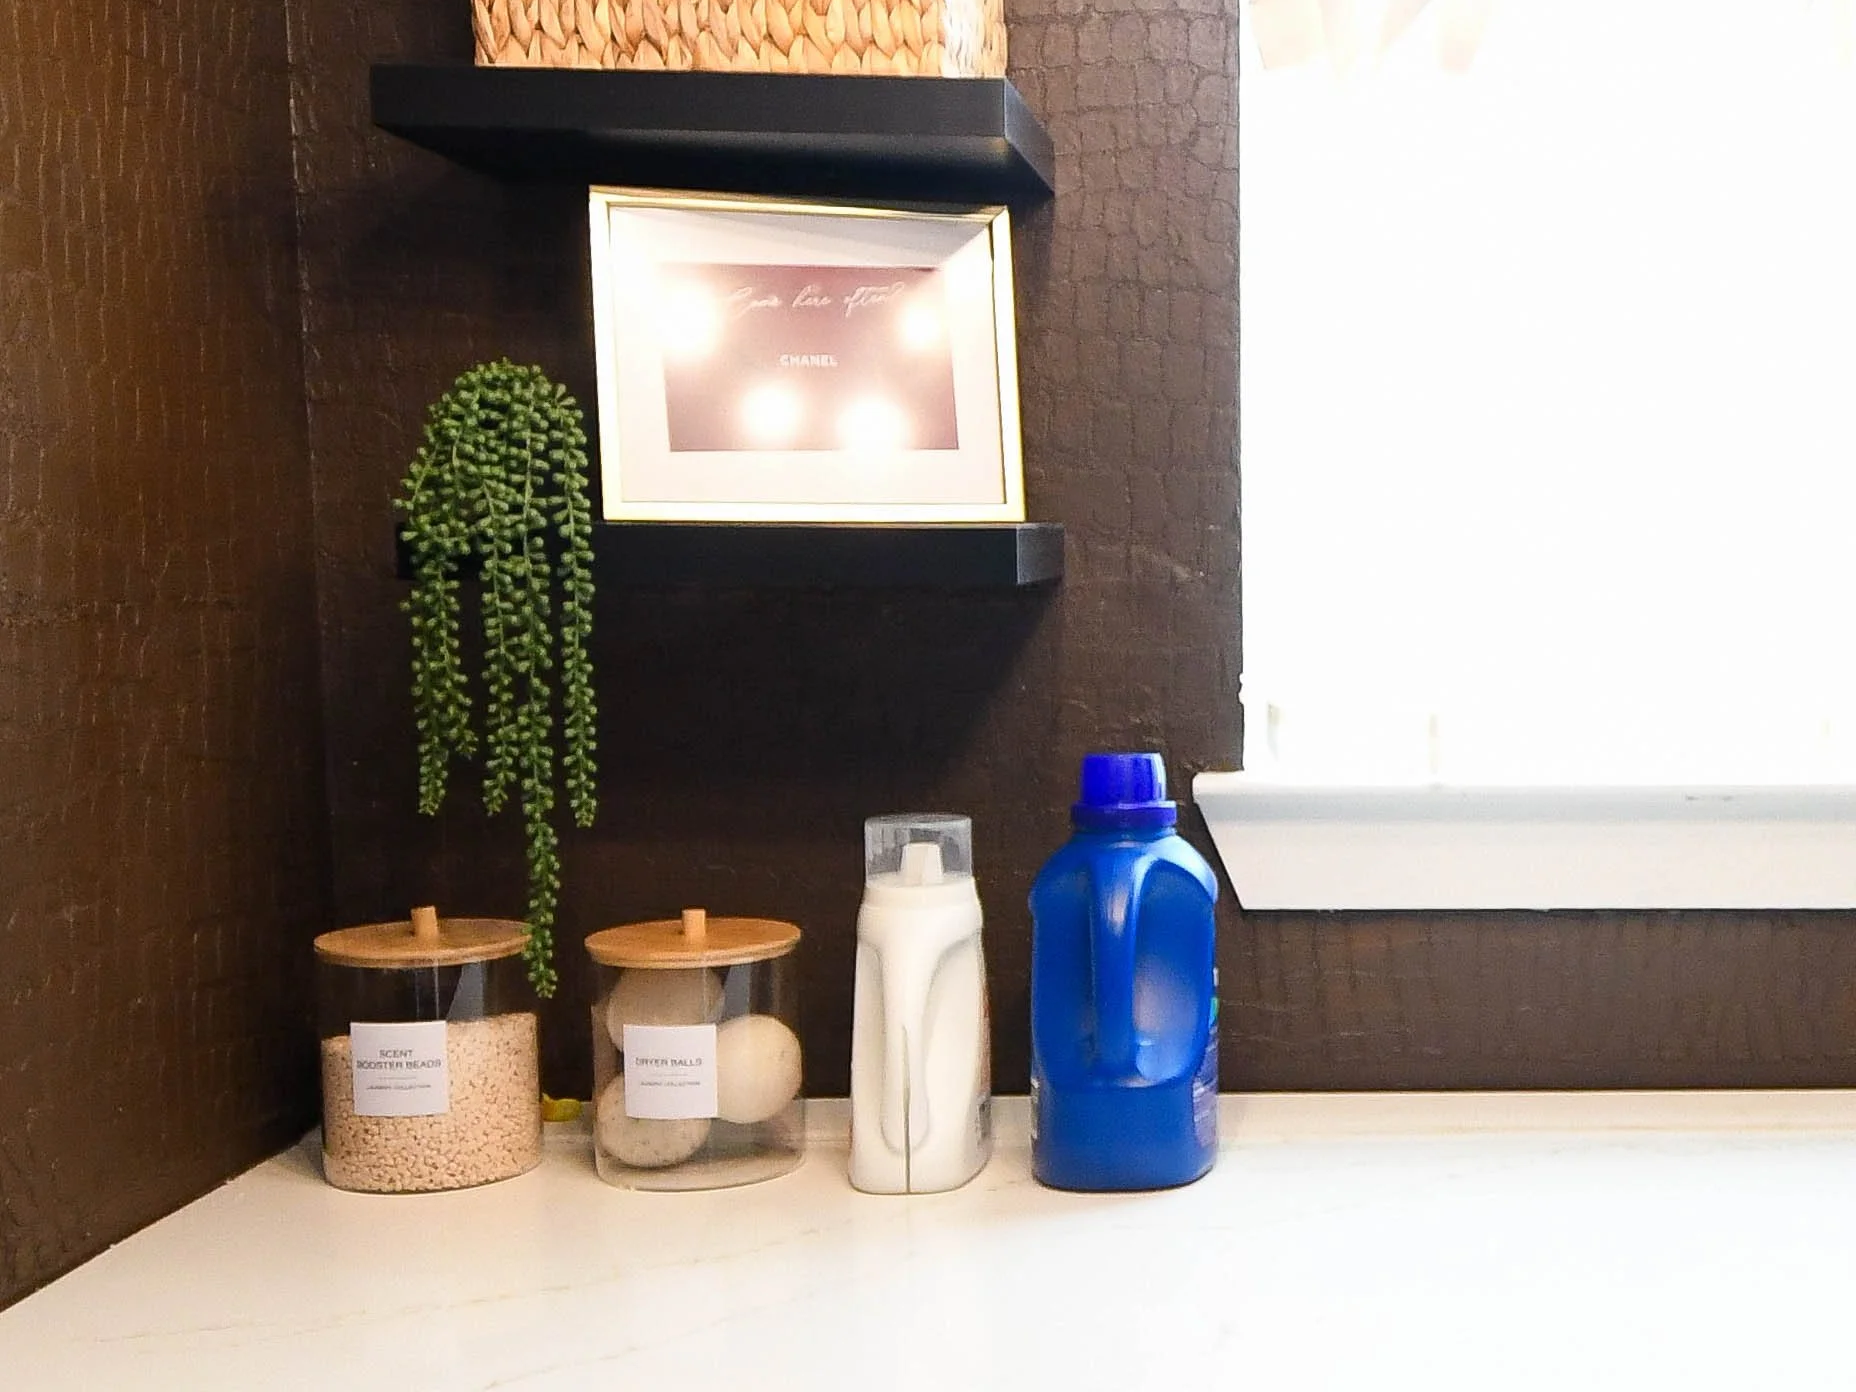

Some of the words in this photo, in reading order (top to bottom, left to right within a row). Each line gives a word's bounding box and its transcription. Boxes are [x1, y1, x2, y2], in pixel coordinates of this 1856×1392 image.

[779, 354, 839, 368] CHANEL
[379, 1049, 413, 1059] SCENT
[356, 1060, 403, 1070] BOOSTER
[405, 1058, 442, 1069] BEADS
[635, 1057, 668, 1067] DRYER
[670, 1057, 702, 1067] BALLS
